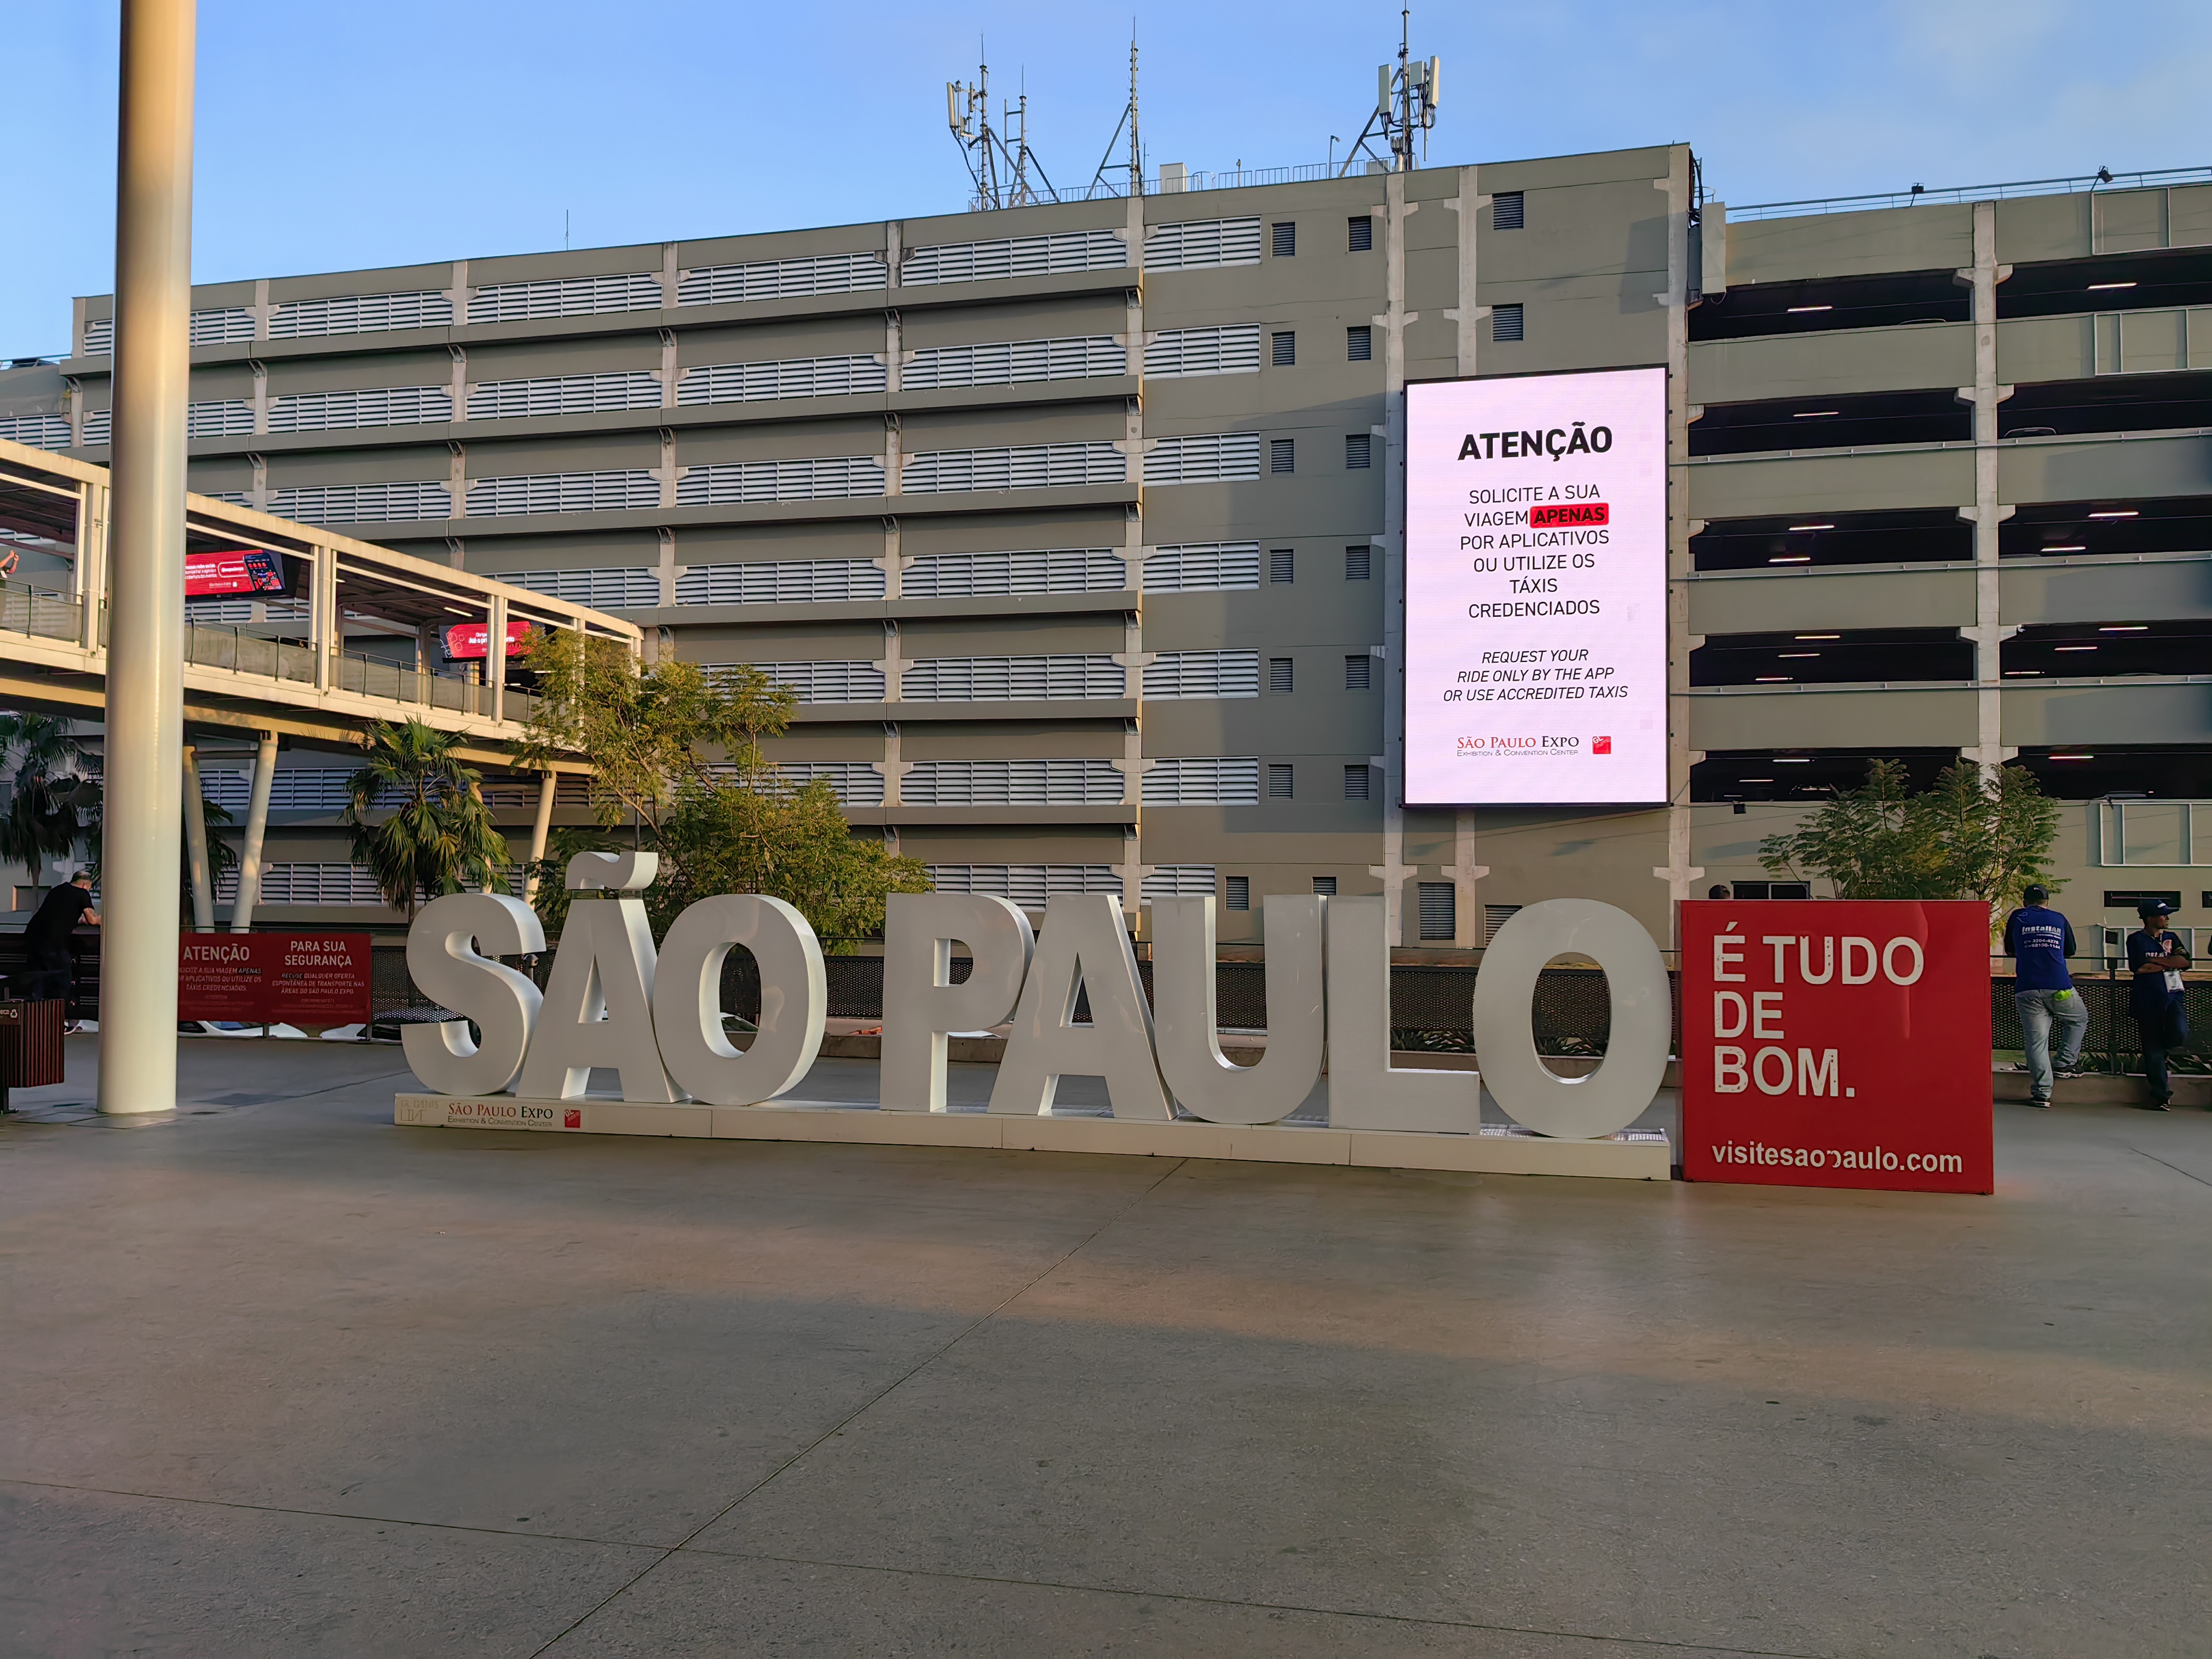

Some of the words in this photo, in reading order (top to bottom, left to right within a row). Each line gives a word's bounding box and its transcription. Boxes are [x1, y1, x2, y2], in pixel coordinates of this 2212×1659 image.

[1458, 421, 1613, 462] ATENÇÃO
[1469, 487, 1543, 504] SOLICITE
[1548, 485, 1560, 501] A
[1564, 484, 1601, 499] SUA
[1464, 510, 1528, 527] VIAGEM
[1533, 506, 1605, 524] APENAS
[1460, 535, 1494, 550] POR
[1499, 530, 1609, 549] APLICATIVOS
[1474, 557, 1497, 572] OU
[1503, 555, 1567, 571] UTILIZE
[1572, 554, 1595, 568] OS
[1509, 575, 1558, 594] TÁXIS
[1468, 600, 1600, 618] CREDENCIADOS
[1481, 651, 1547, 664] REQUEST
[1550, 649, 1589, 662] YOUR
[1458, 671, 1489, 683] RIDE
[1493, 669, 1528, 682] ONLY
[1532, 669, 1551, 681] BY
[1554, 668, 1582, 680] THE
[1584, 667, 1614, 679] APP
[1443, 690, 1462, 702] OR
[1466, 689, 1495, 701] USE
[1497, 687, 1584, 701] ACCREDITED
[1589, 685, 1628, 698] TAXIS
[183, 943, 250, 964] ATENÇÃO
[291, 941, 320, 952] PARA
[323, 941, 347, 952] SUA
[1713, 921, 1746, 982] É
[1762, 935, 1925, 986] TUDO
[285, 955, 352, 968] SEGURANÇA
[401, 852, 828, 1105] SÃO
[880, 892, 1673, 1139] PAULO
[1714, 990, 1784, 1039] DE
[1714, 1046, 1856, 1098] BOM.
